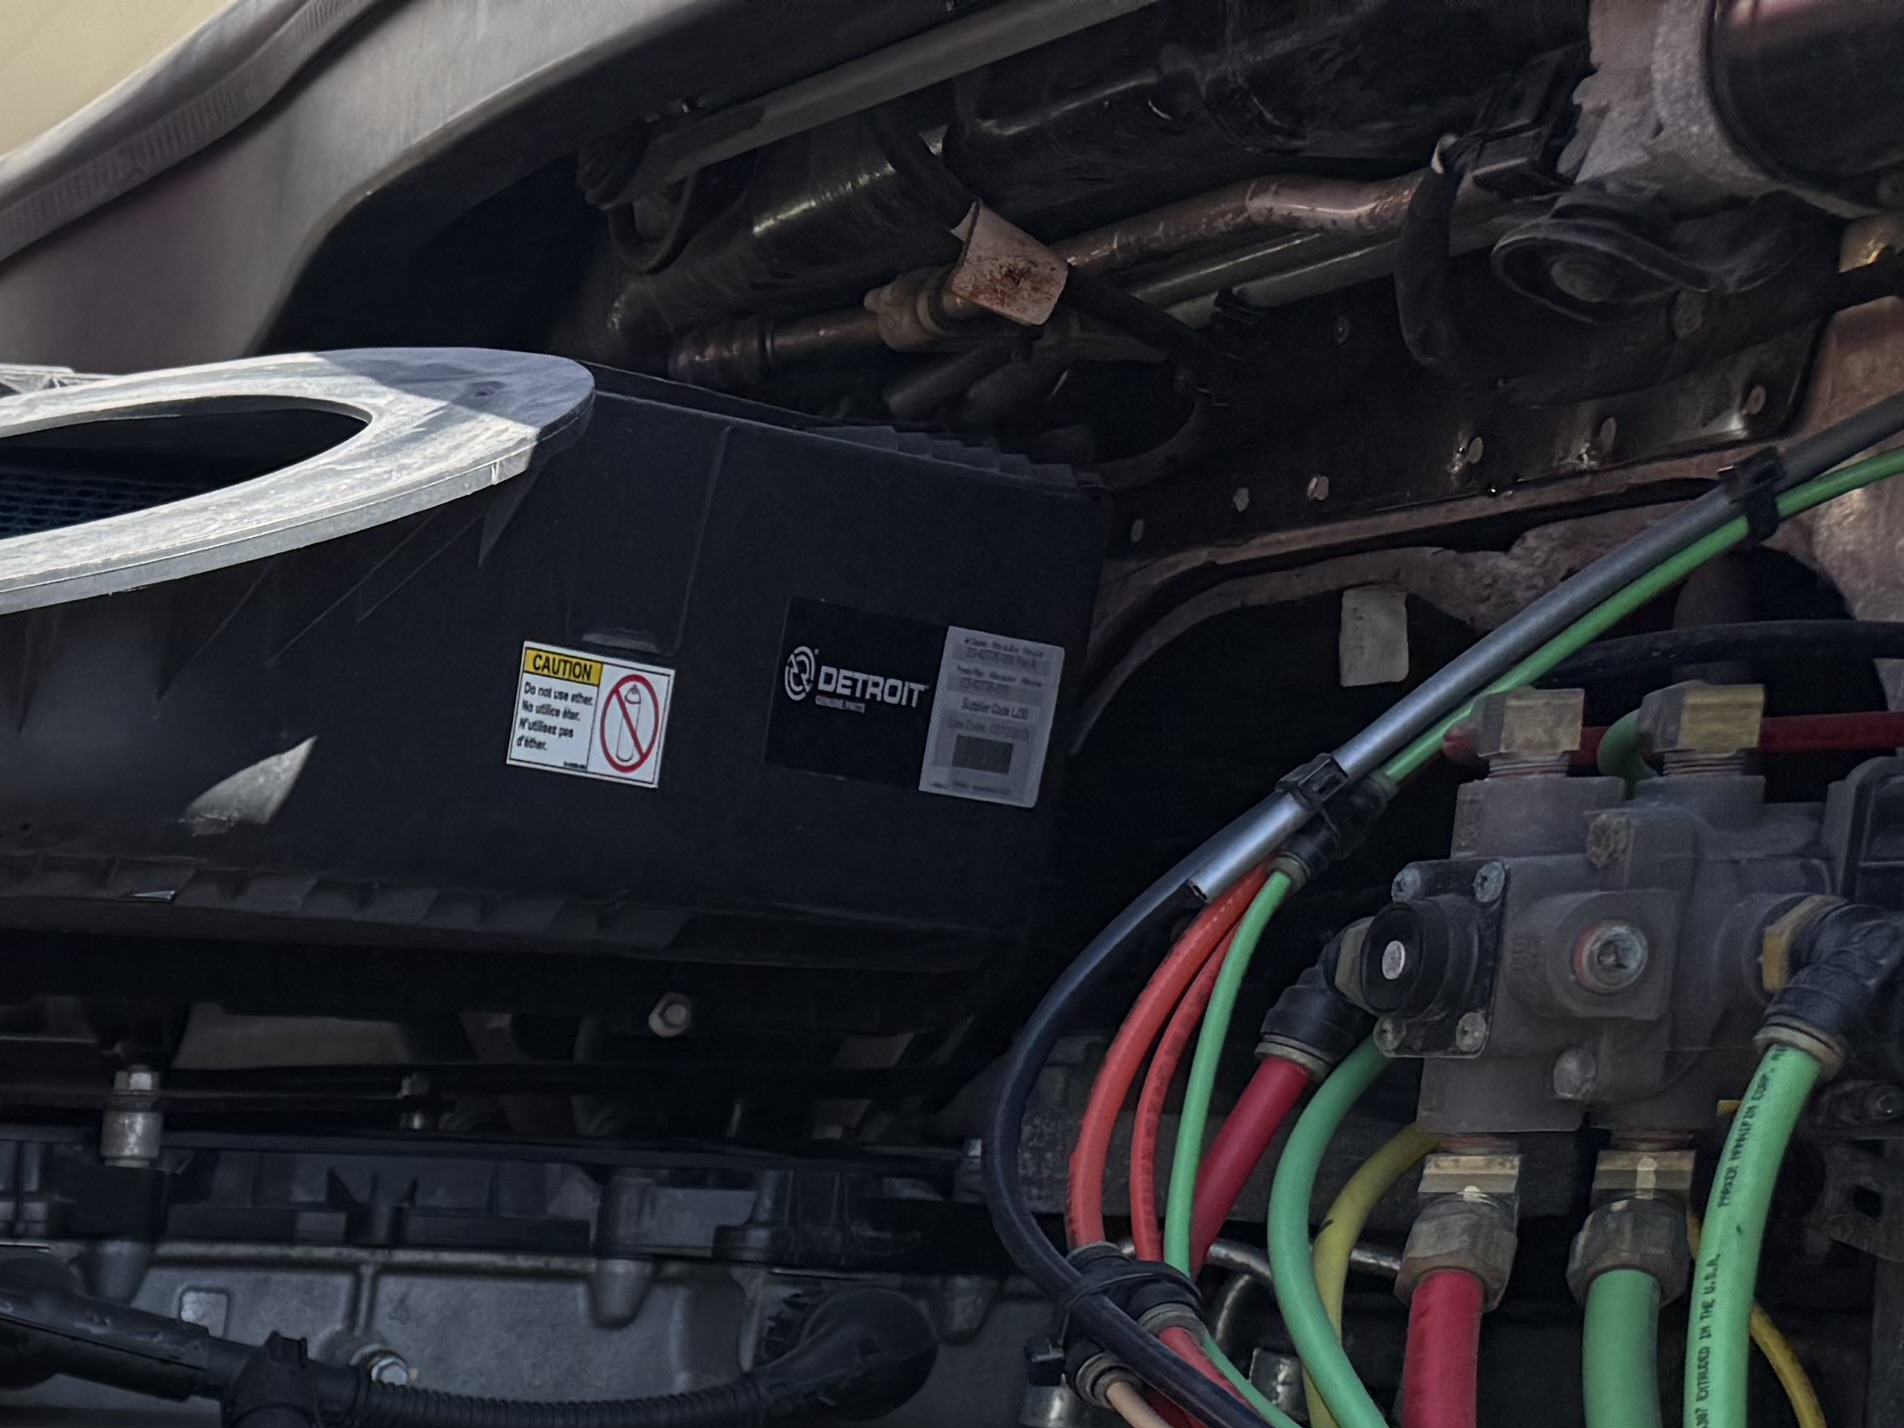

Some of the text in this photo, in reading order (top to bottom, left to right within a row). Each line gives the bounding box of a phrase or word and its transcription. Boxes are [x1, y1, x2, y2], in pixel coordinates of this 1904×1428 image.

[533, 655, 592, 681] CAUTION
[524, 682, 536, 694] Do
[538, 685, 552, 698] not
[554, 690, 568, 701] use
[817, 665, 927, 708] DETROIT
[523, 700, 533, 713] No
[1700, 1298, 1716, 1321] THE
